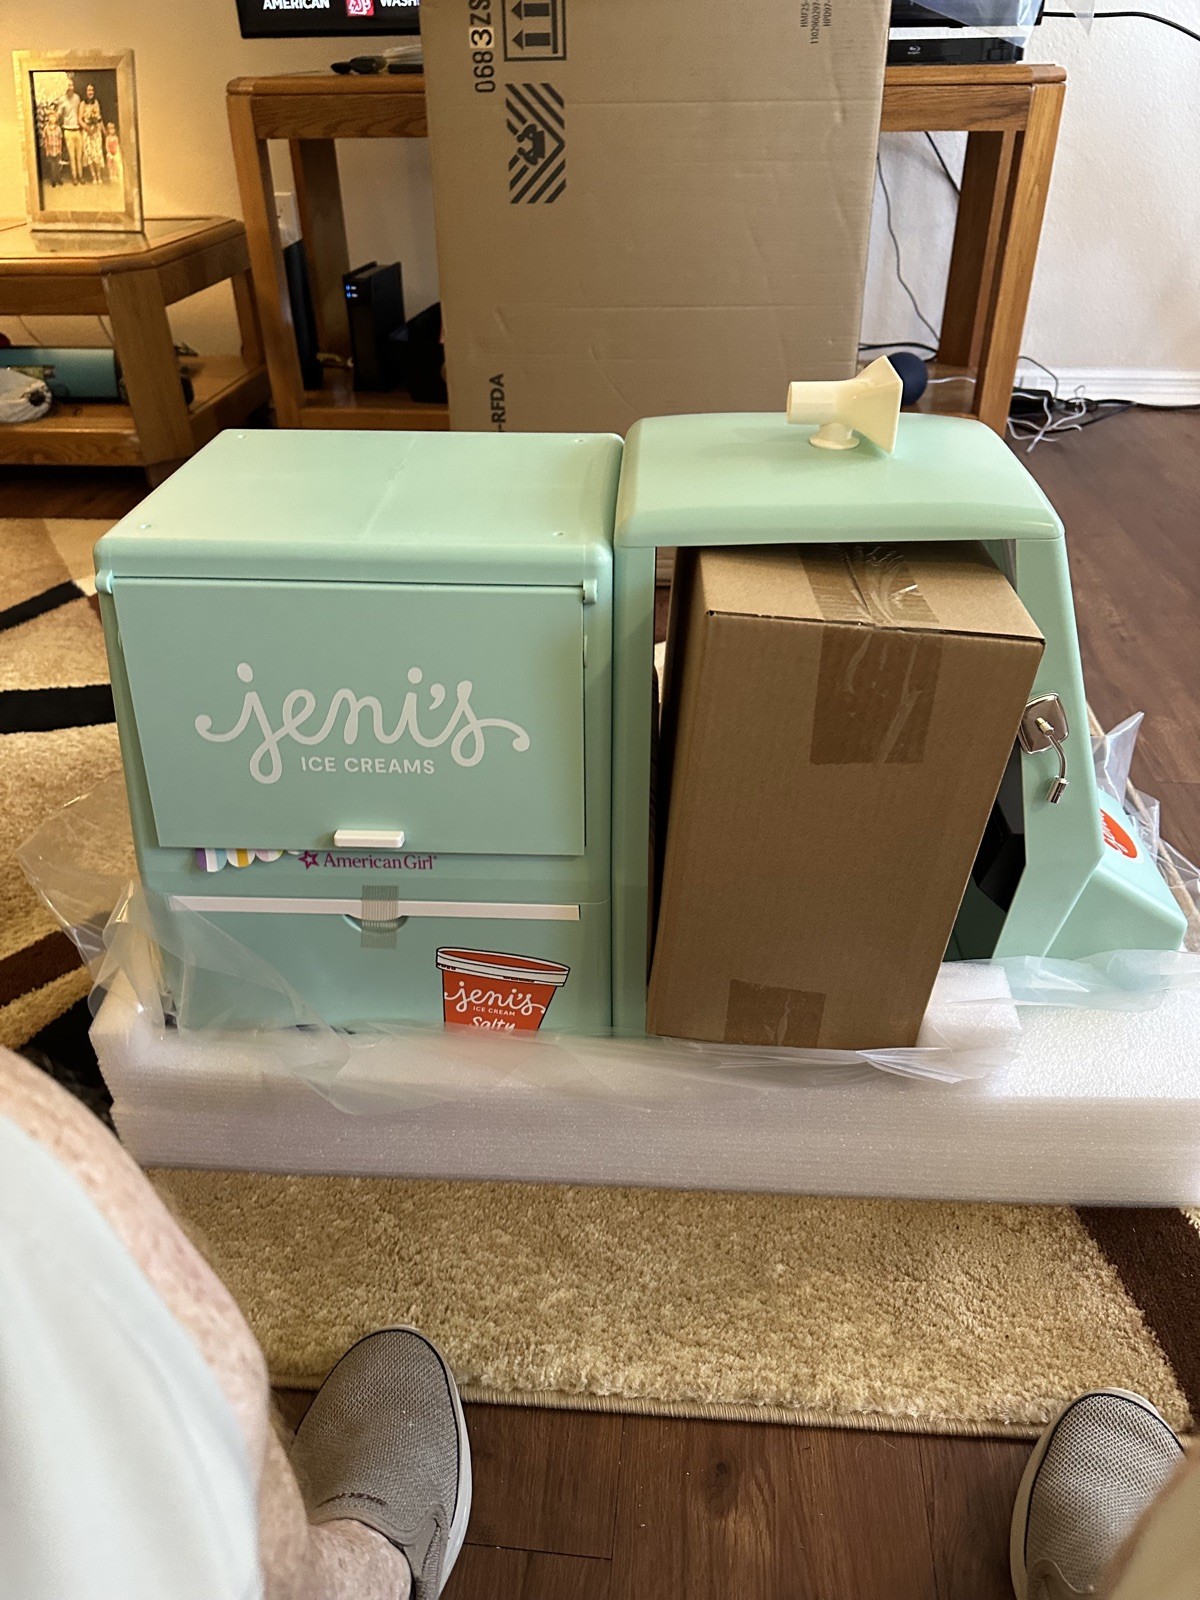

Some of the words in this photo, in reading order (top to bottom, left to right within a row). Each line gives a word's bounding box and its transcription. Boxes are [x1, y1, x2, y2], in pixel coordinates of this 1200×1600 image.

[263, 0, 330, 10] AMERICAN
[469, 0, 496, 93] 0683ZS
[489, 373, 506, 432] -RFDA
[195, 662, 530, 784] jeni's
[301, 756, 336, 772] ICE
[344, 757, 435, 775] CREAMS
[324, 852, 402, 869] American
[403, 854, 433, 870] Girl
[444, 980, 547, 1016] jeni's
[488, 1007, 516, 1017] CREAM
